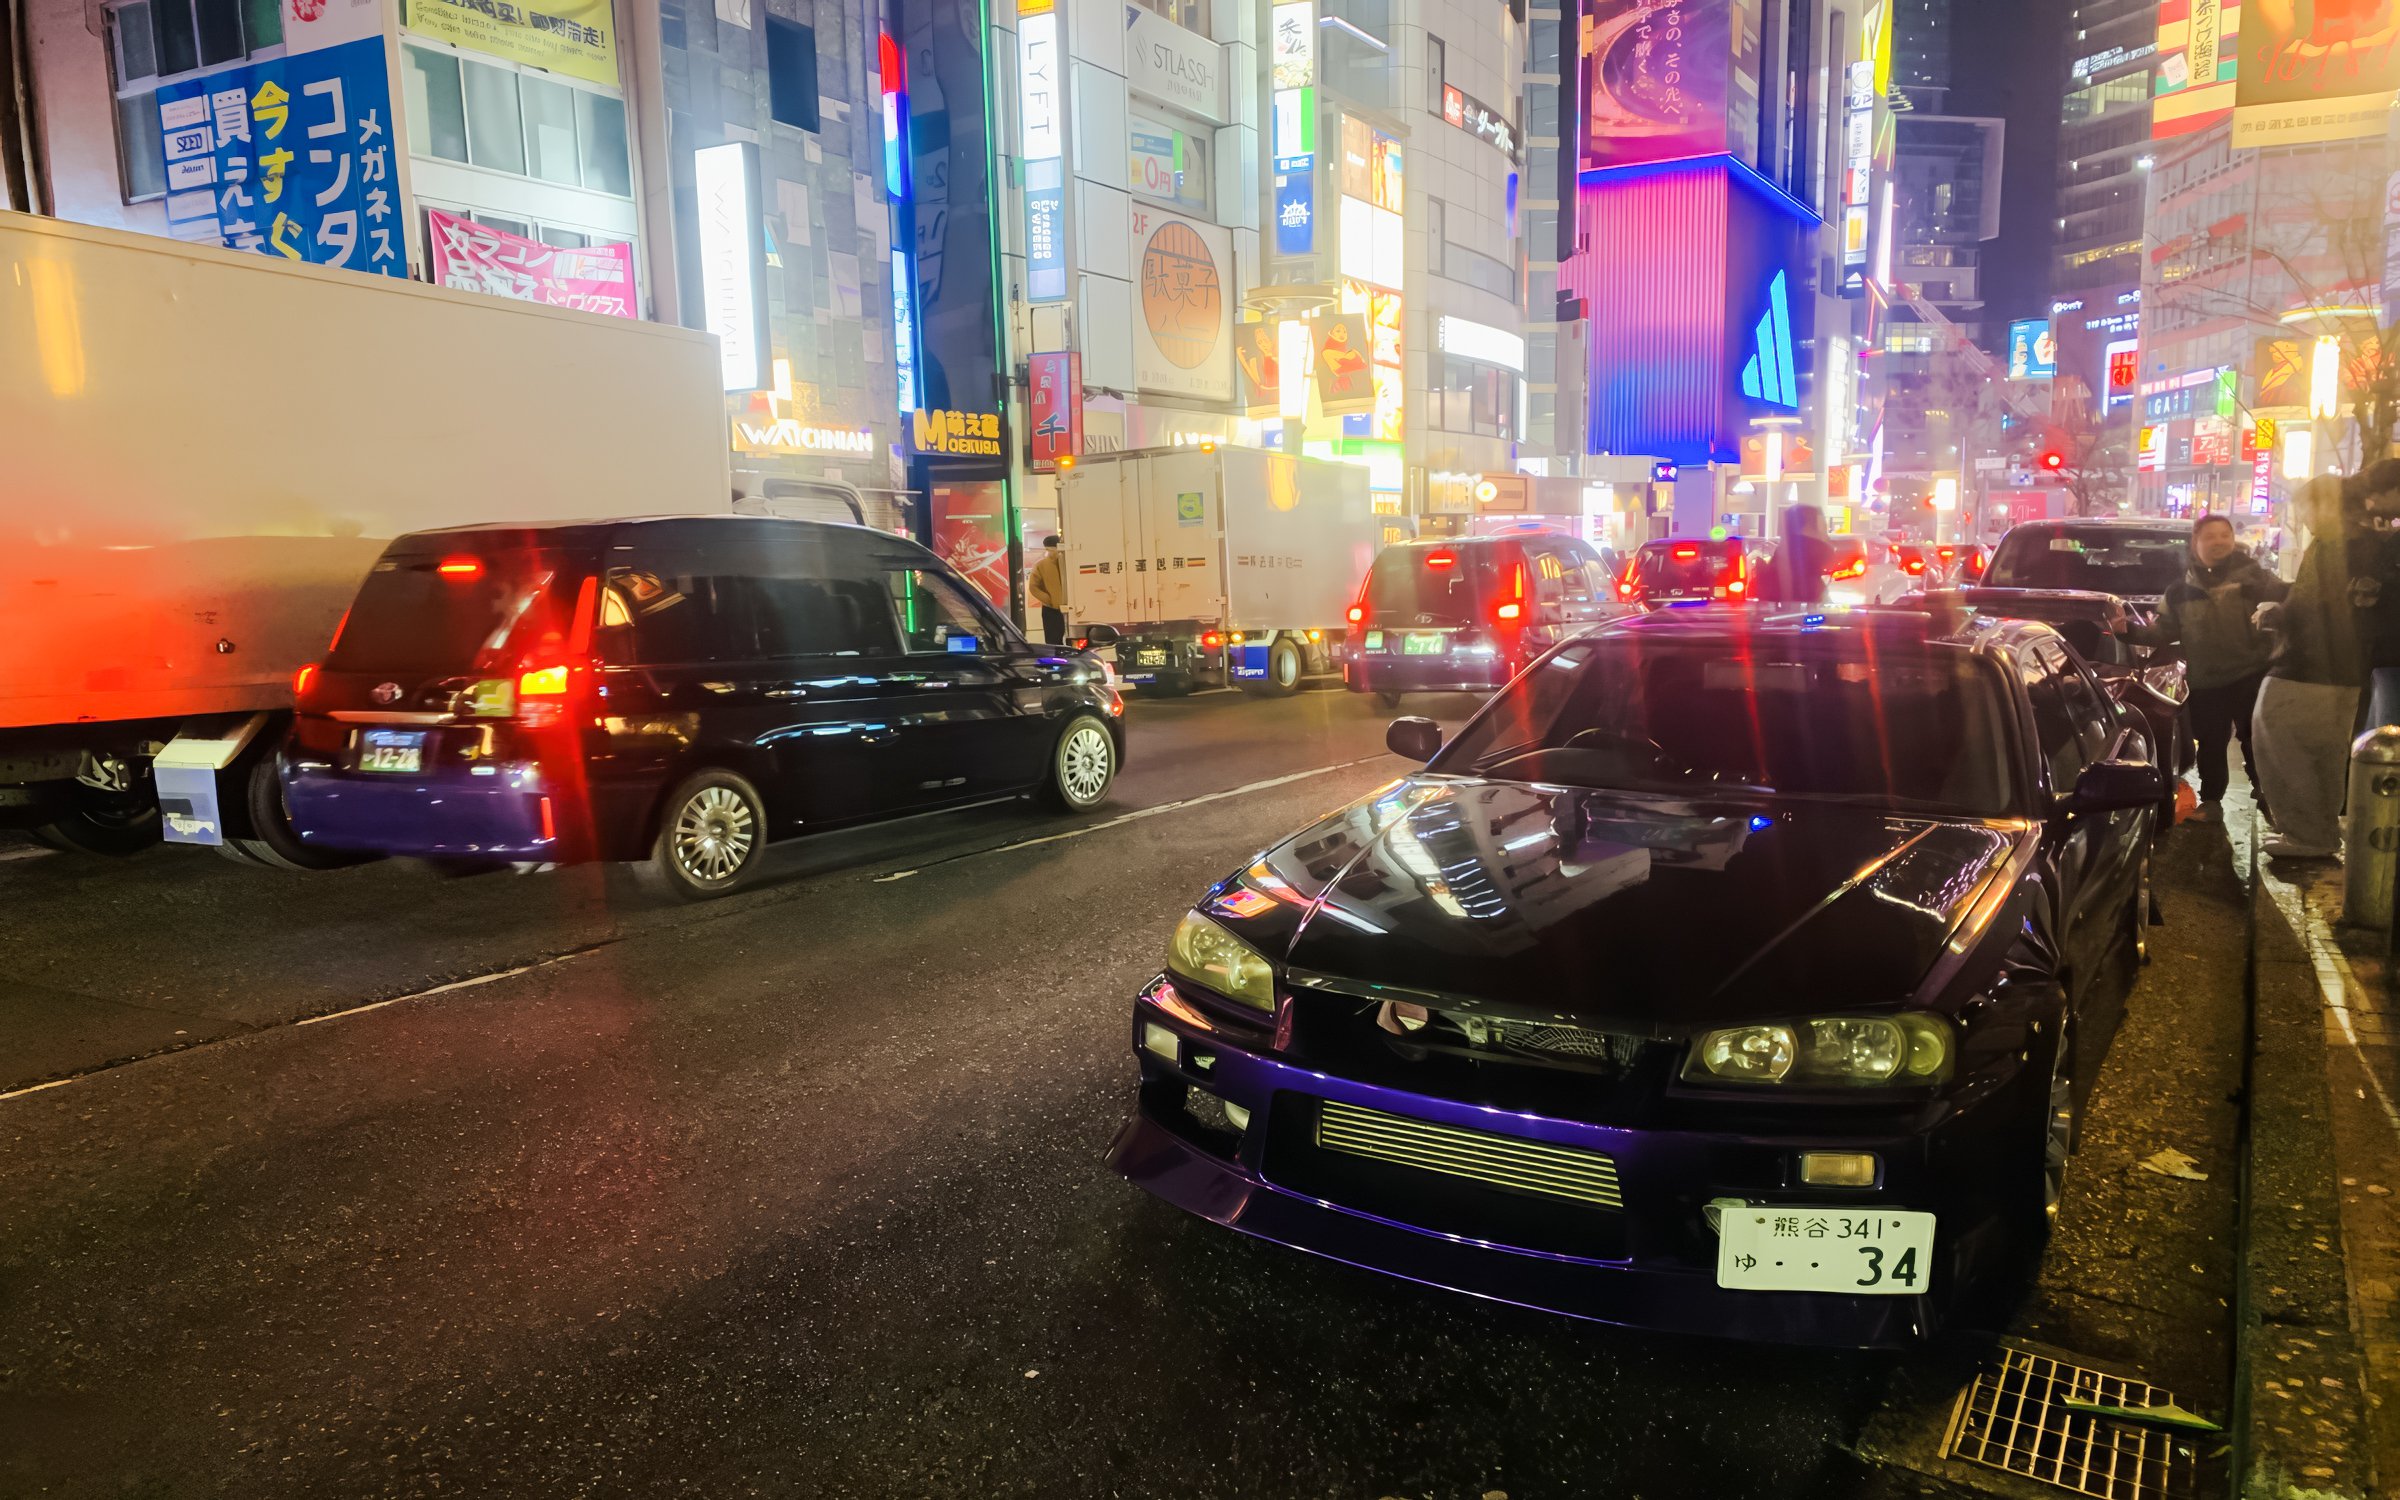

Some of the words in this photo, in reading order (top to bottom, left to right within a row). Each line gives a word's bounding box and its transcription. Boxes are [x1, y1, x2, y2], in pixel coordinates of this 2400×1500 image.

[1028, 40, 1050, 135] LYFT
[1154, 43, 1215, 92] STLASSH
[250, 80, 303, 260] 今すぐ
[303, 77, 357, 267] コンタ
[359, 108, 395, 277] メガネス
[1133, 212, 1149, 236] 2F
[1036, 412, 1068, 452] 千
[1774, 1216, 1830, 1238] 熊谷
[1837, 1218, 1882, 1239] 341
[1735, 1253, 1757, 1272] ゆ
[1856, 1246, 1918, 1287] 34
